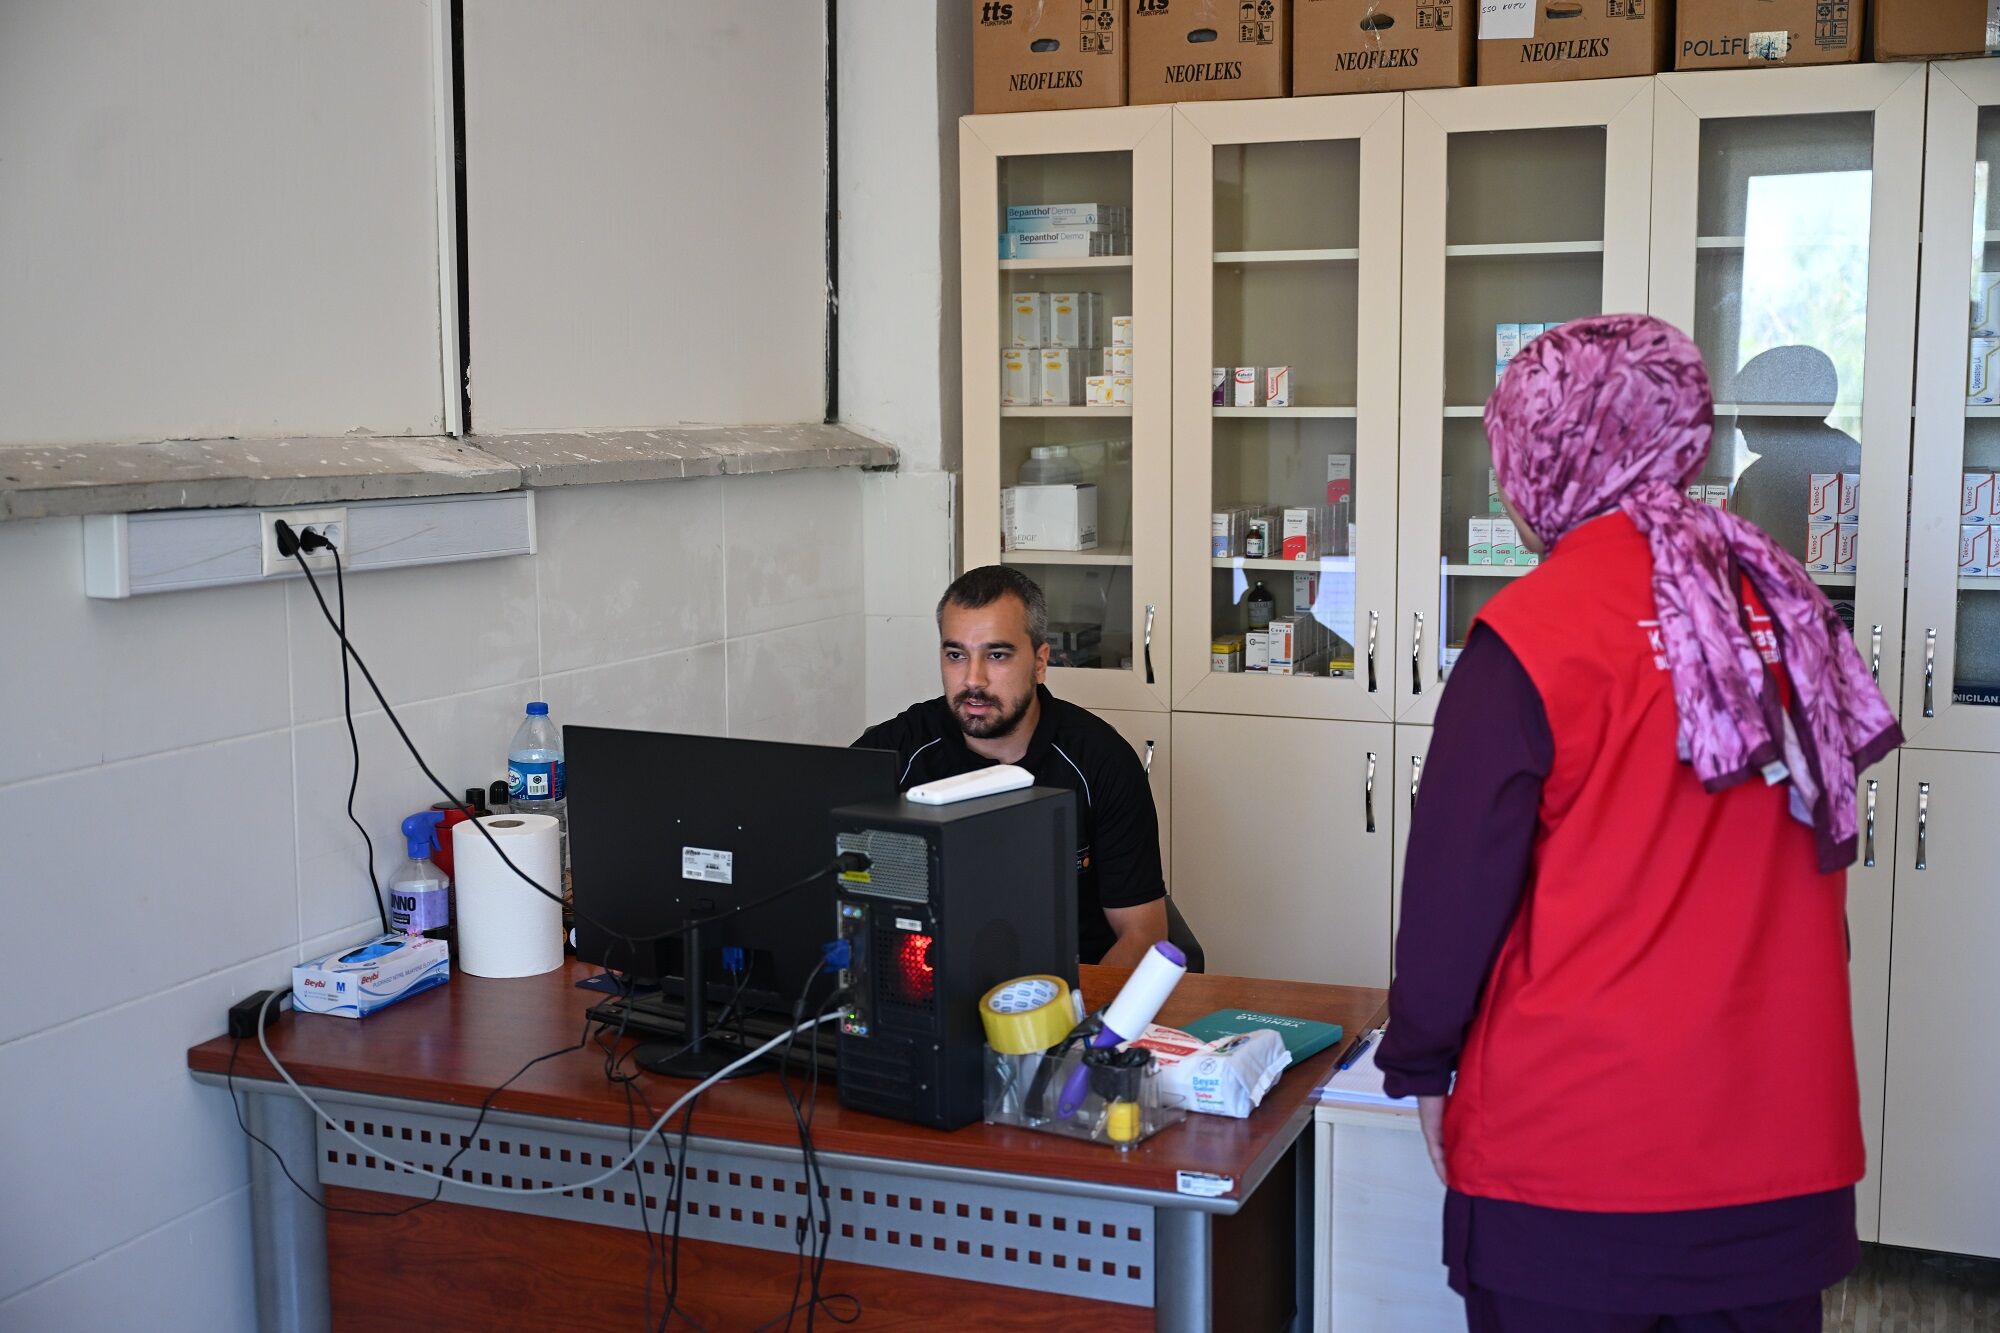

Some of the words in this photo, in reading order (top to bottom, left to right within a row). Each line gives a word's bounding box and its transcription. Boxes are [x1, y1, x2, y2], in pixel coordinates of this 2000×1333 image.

[982, 2, 1014, 22] tts
[1520, 37, 1610, 63] NEOFLEKS
[1683, 36, 1792, 57] POLİFLS
[1334, 48, 1419, 72] NEOFLEKS
[1009, 70, 1083, 91] NEOFLEKS
[1165, 61, 1242, 84] NEOFLEKS
[1009, 207, 1050, 217] Bepanthol
[1051, 206, 1077, 215] Derma
[1019, 233, 1059, 243] Bepanthol
[1060, 232, 1084, 240] Derma
[304, 978, 326, 988] Beybi
[336, 981, 345, 992] M
[361, 970, 379, 985] Beybi
